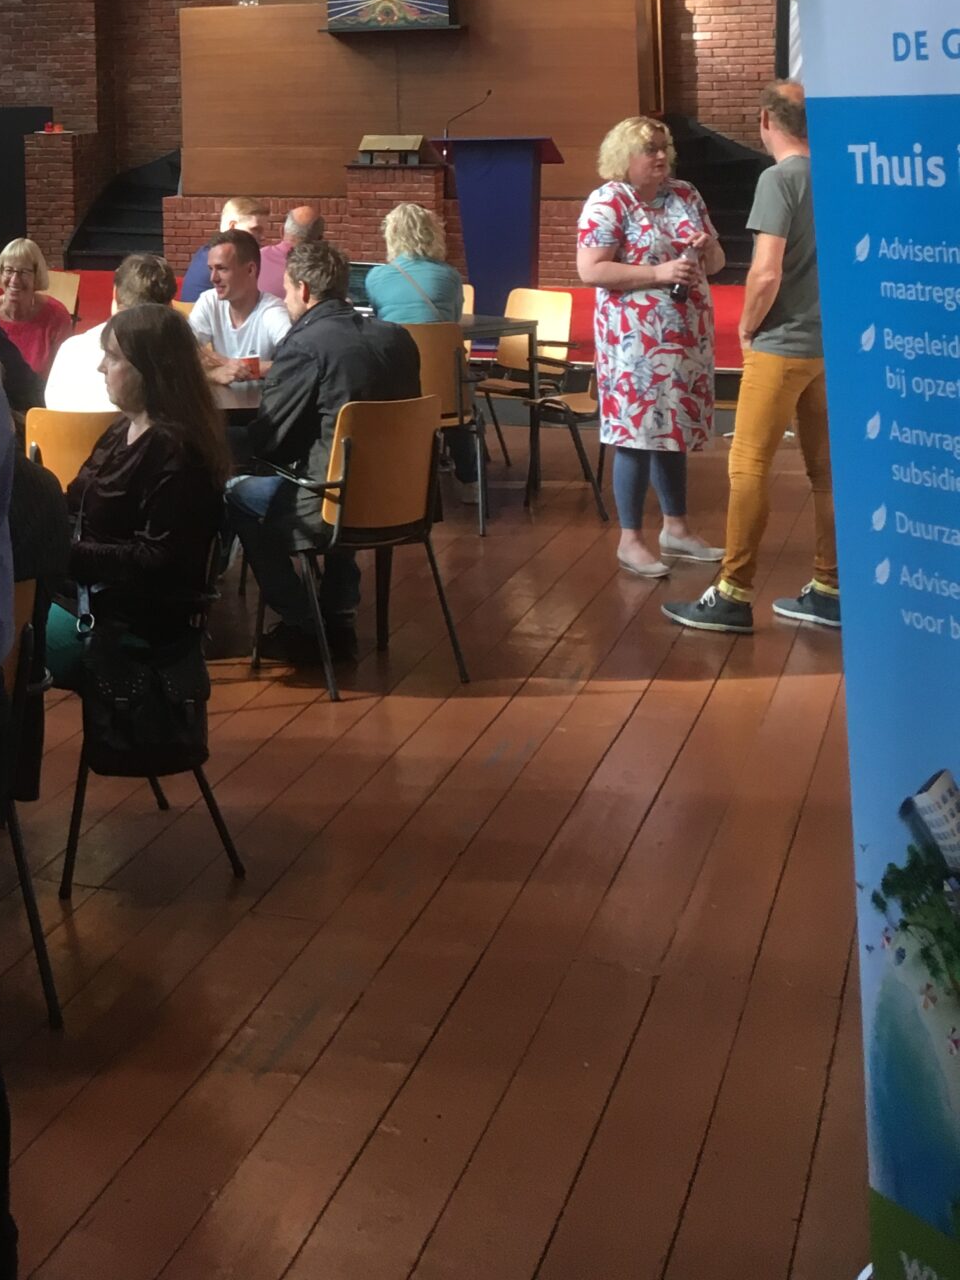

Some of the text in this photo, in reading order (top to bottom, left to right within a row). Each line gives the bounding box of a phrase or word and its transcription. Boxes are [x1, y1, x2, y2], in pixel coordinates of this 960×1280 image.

[892, 29, 930, 62] DE
[848, 140, 947, 187] Thuis
[878, 236, 960, 265] Adviserin
[883, 327, 960, 360] Begeleid
[885, 365, 906, 398] bij
[895, 511, 960, 546] Duurza
[899, 564, 960, 600] Advise
[900, 608, 944, 634] voor
